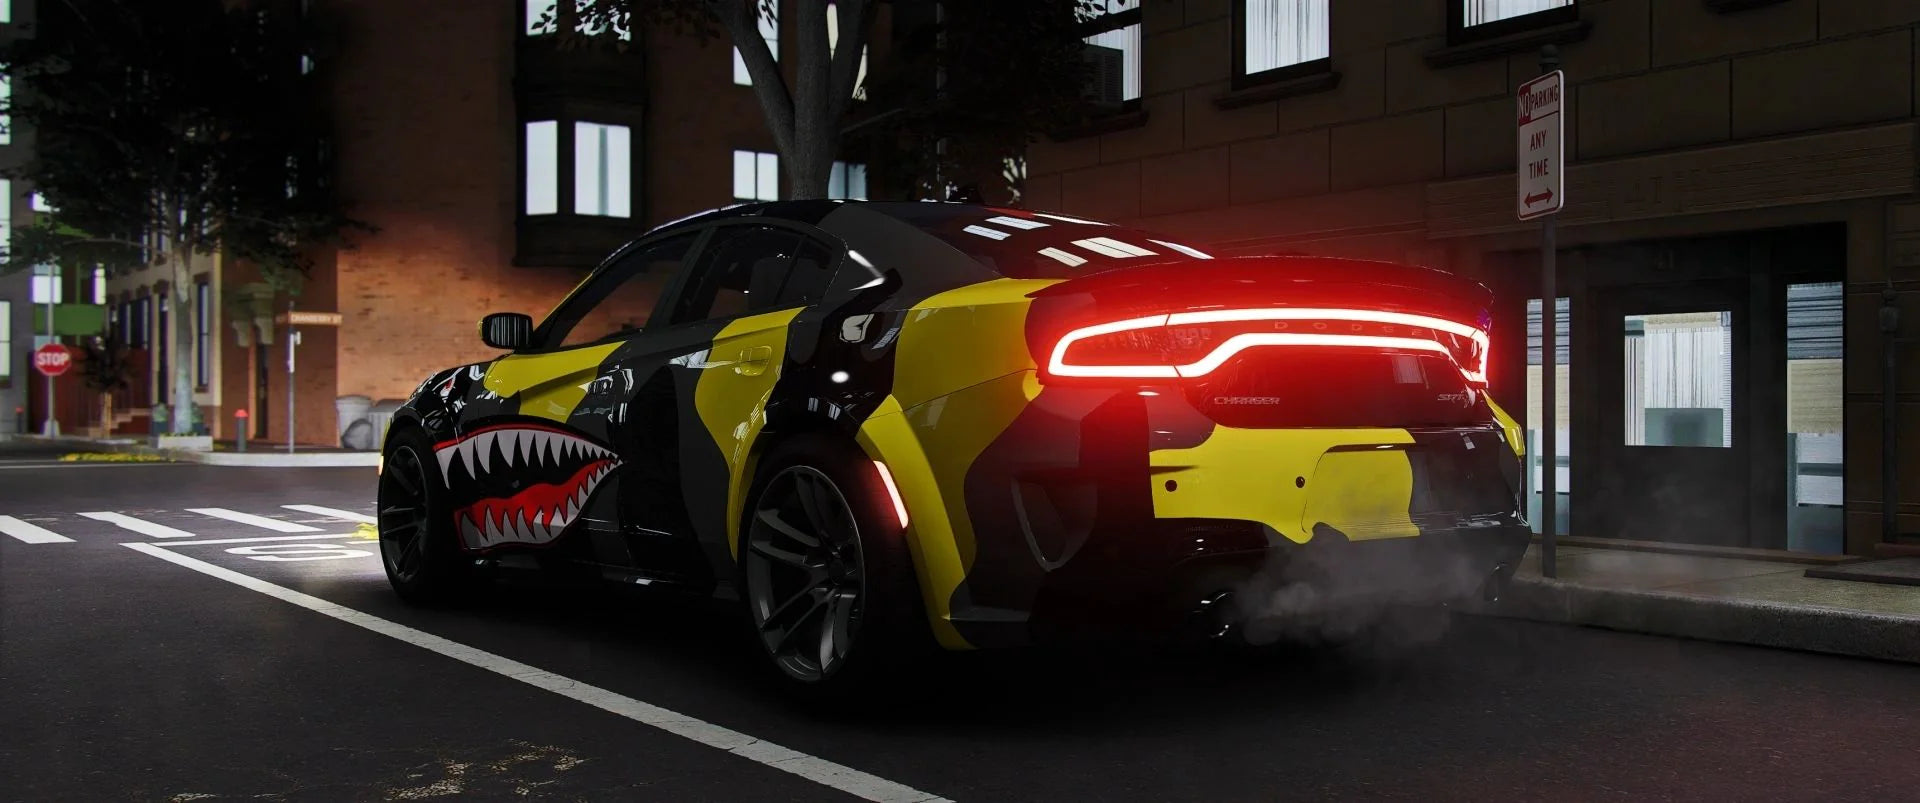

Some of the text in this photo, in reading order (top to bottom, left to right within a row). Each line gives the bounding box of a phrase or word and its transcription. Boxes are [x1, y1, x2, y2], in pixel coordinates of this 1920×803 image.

[1519, 84, 1558, 119] NO PARKING
[1530, 130, 1547, 151] ANY
[1529, 158, 1549, 179] TIME
[37, 352, 70, 366] STOP
[1213, 396, 1281, 405] CHARGER
